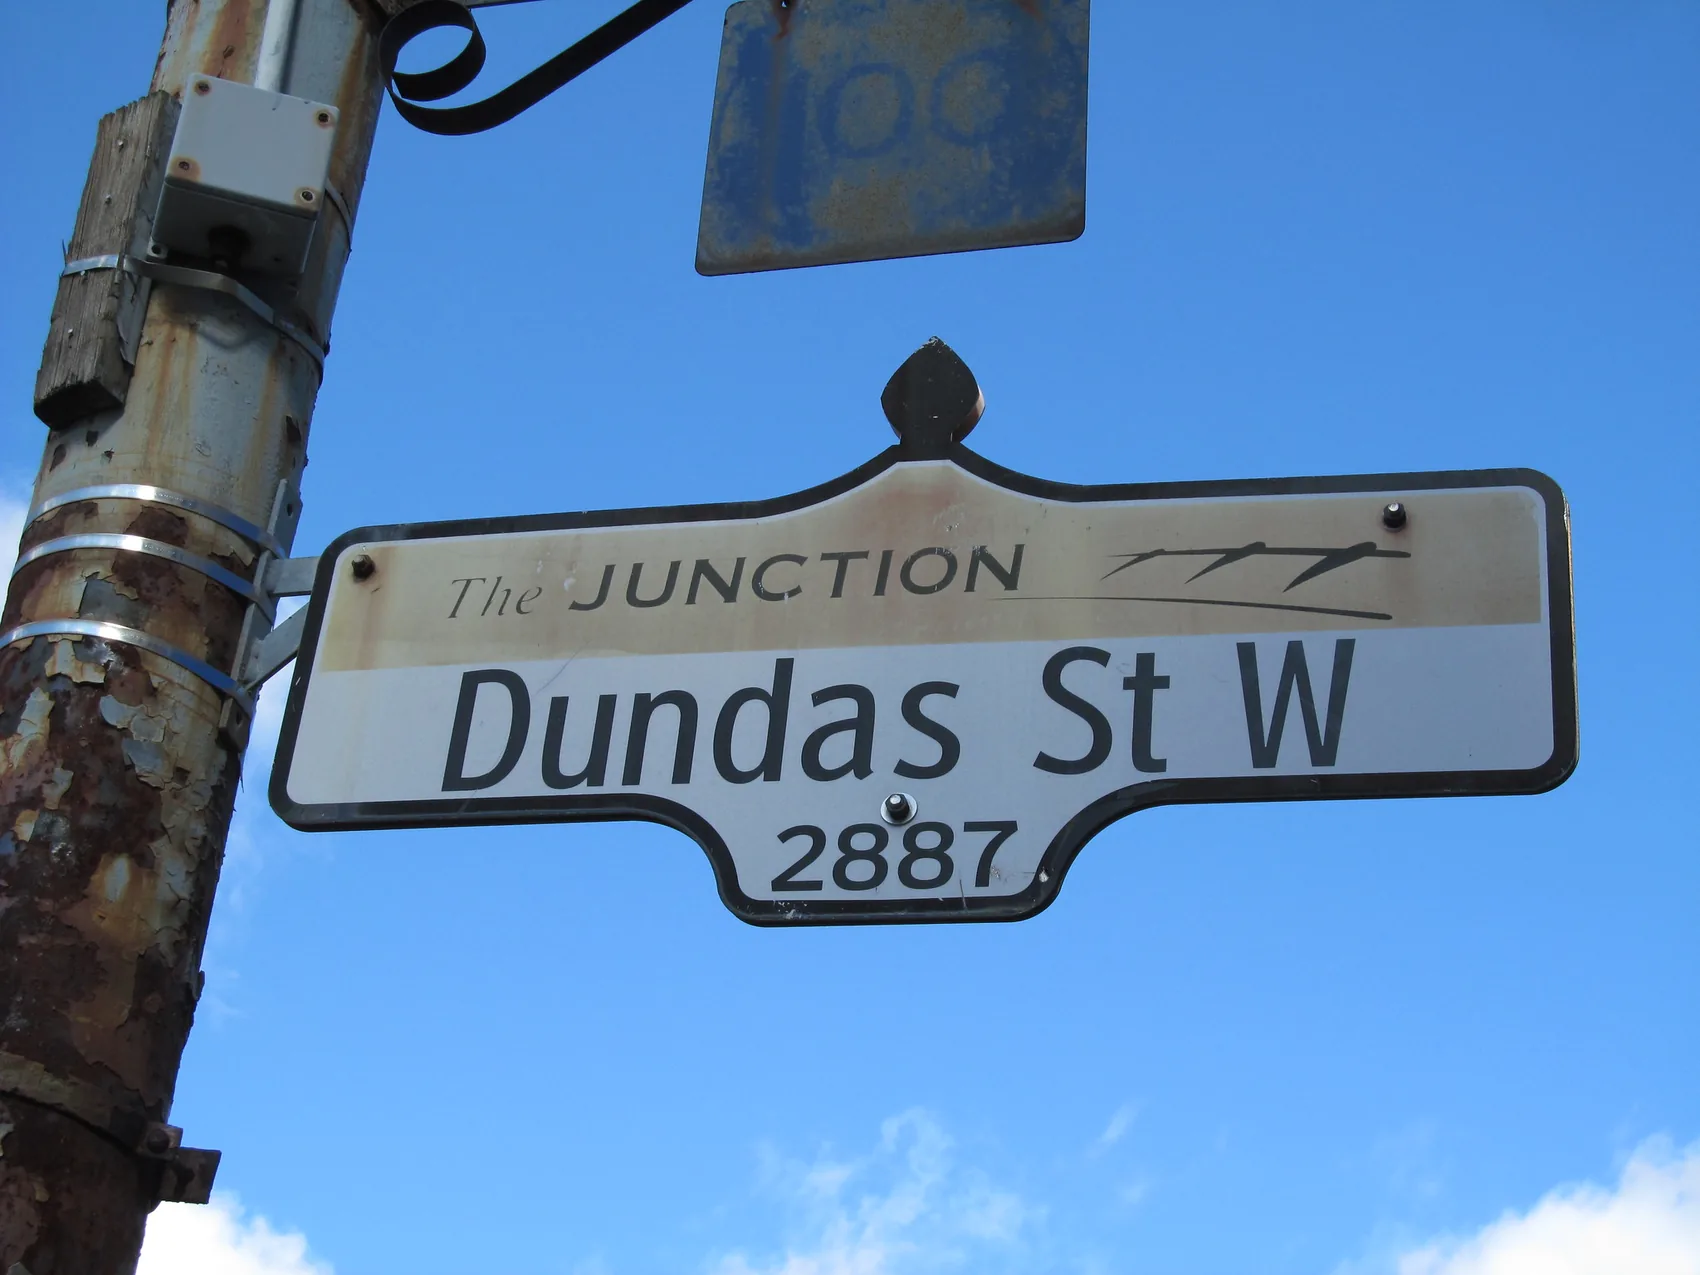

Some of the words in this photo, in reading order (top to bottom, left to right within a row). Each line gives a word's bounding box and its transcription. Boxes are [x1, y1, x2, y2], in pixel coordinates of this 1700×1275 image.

[448, 576, 543, 619] The
[569, 543, 1026, 612] JUNCTION
[441, 657, 961, 792] Dundas
[1032, 646, 1171, 776] St
[1235, 638, 1357, 769] W
[770, 820, 1019, 892] 2887
